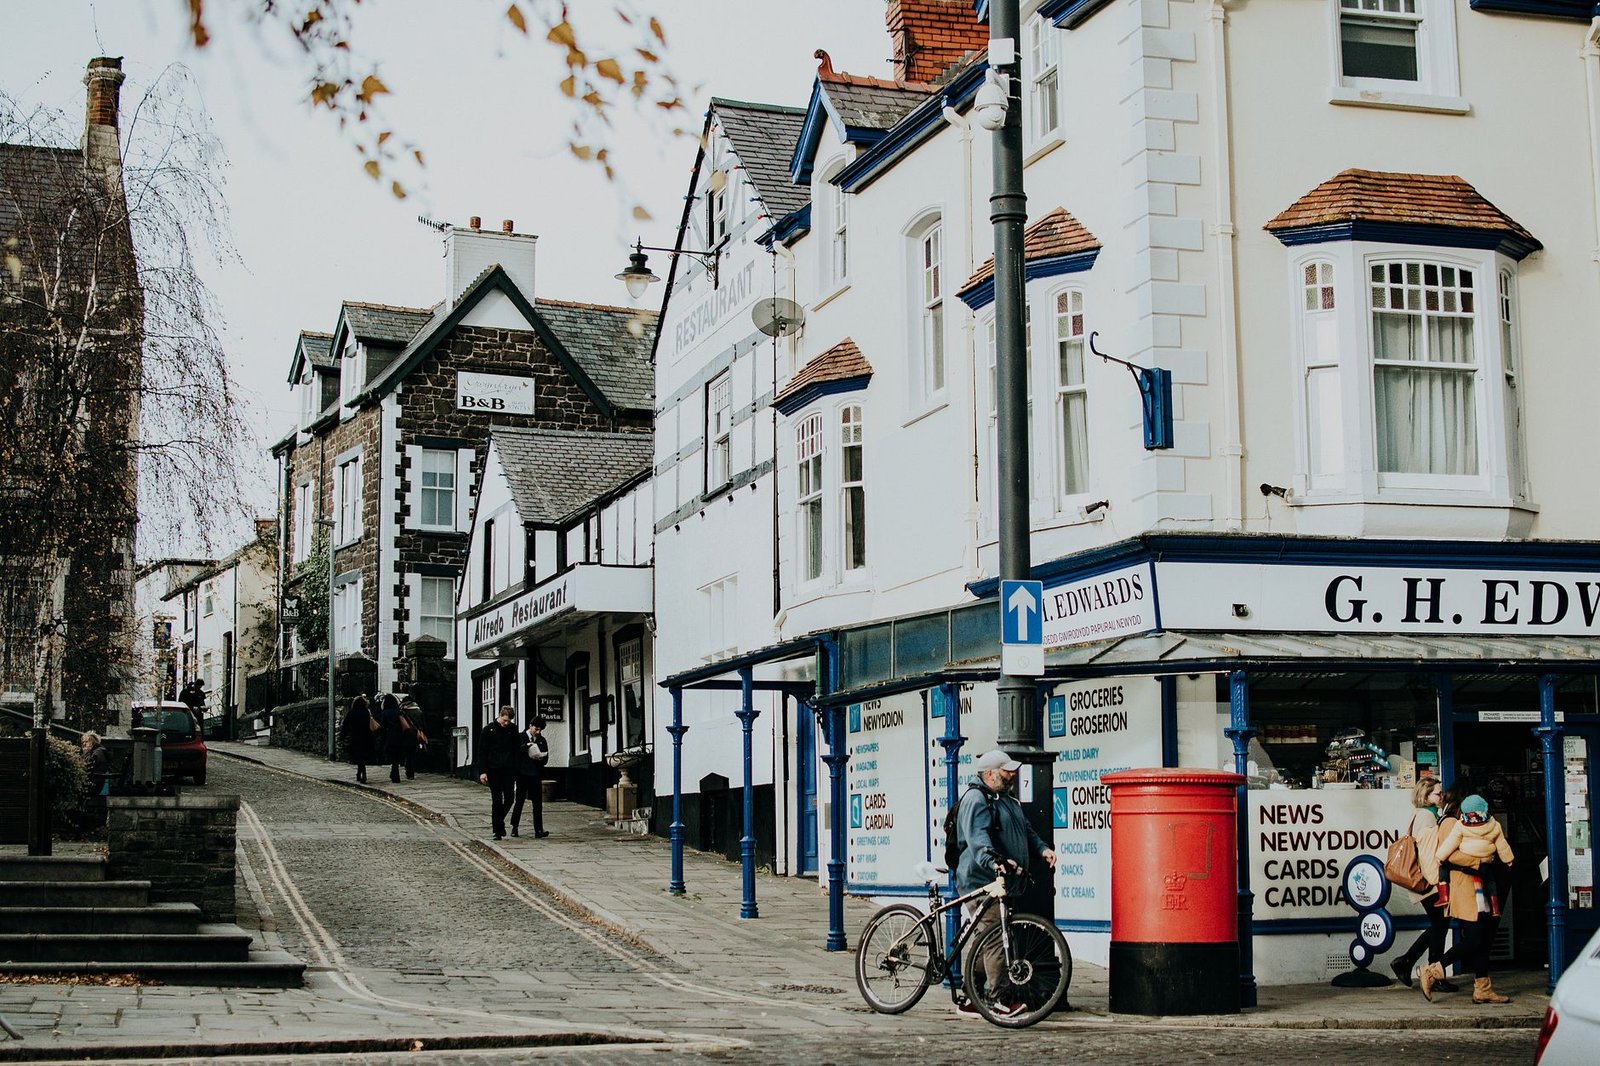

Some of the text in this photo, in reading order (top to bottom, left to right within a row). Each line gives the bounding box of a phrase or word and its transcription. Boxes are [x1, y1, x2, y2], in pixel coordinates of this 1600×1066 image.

[676, 260, 754, 354] RESTAURANT
[461, 395, 505, 410] B&B
[1054, 573, 1144, 619] EDWARDS
[1324, 575, 1383, 623] G.
[1401, 577, 1463, 624] H.
[474, 579, 567, 645] Alfredo Restaurant
[1116, 614, 1142, 629] NEWYDD
[1069, 685, 1124, 711] GROCERIES
[863, 710, 904, 731] NEWYDDION
[1070, 711, 1128, 736] GROSERION
[855, 742, 880, 754] NEWSPAPERS
[1058, 747, 1100, 761] CHILLED DAIRY
[855, 760, 878, 771] MAGAZINES
[1024, 780, 1029, 789] 7
[1059, 769, 1098, 782] CONVENIENCE
[864, 793, 887, 810] CARDS
[1072, 786, 1111, 806] CONFEC
[864, 813, 894, 831] CARDIAU
[1072, 811, 1111, 830] MELYSI
[1259, 804, 1324, 825] NEWS
[1060, 842, 1097, 855] CHOCOLATES
[1260, 829, 1399, 852] NEWYDDION
[1061, 864, 1084, 876] SNACKS
[1264, 859, 1340, 880] CARDS
[1061, 885, 1095, 899] ICE CREAMS
[1264, 886, 1350, 908] CARDIA
[1363, 922, 1381, 931] PLAY
[1363, 930, 1381, 938] NOW
